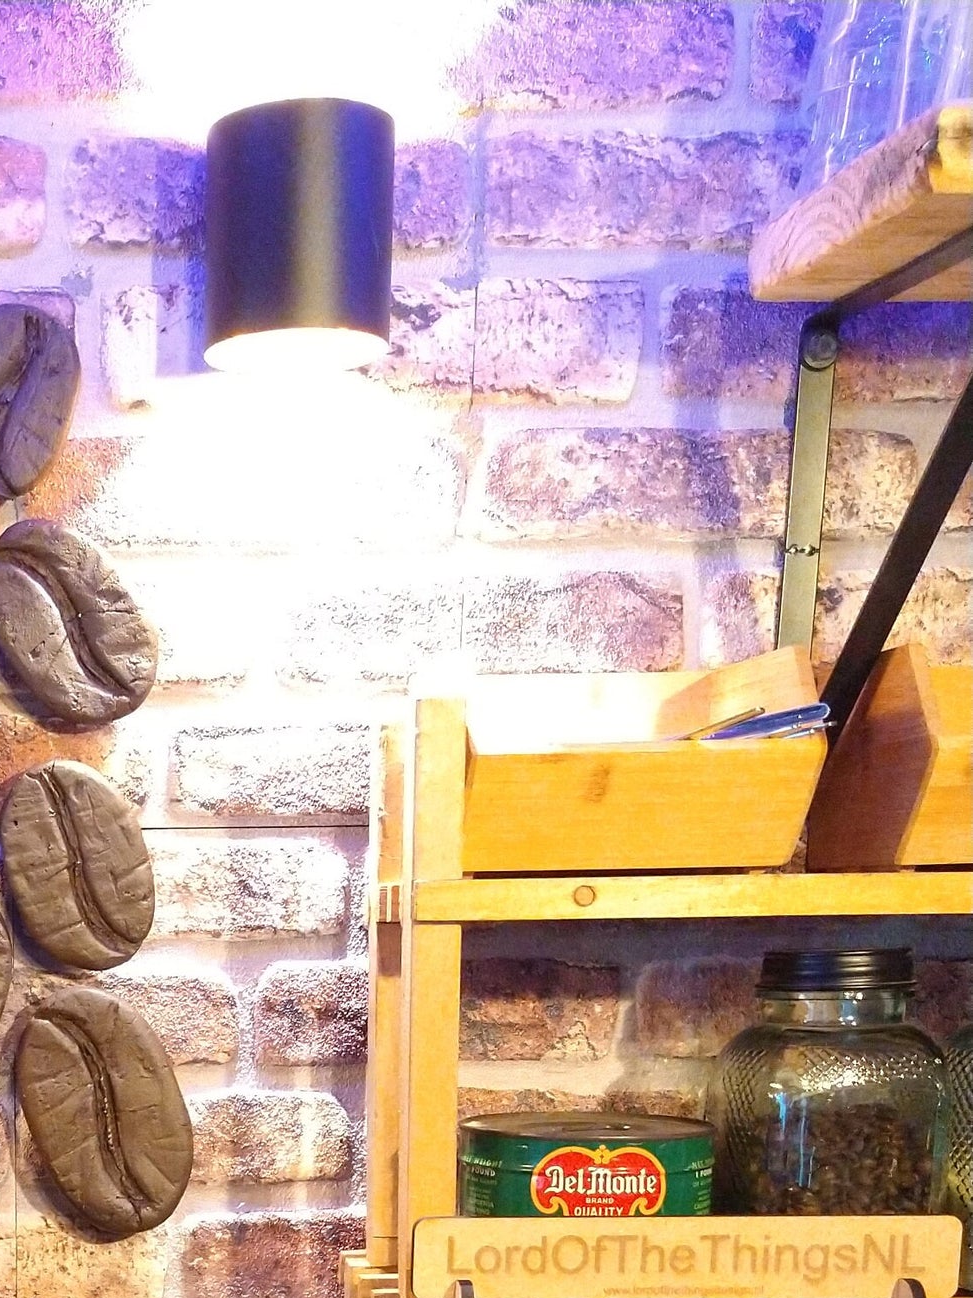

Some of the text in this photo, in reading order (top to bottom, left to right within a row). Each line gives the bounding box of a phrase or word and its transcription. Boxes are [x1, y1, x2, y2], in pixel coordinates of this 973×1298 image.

[585, 1197, 614, 1205] BRAND
[574, 1206, 624, 1216] QUALITY
[446, 1233, 926, 1281] LordOfTheThingsNL
